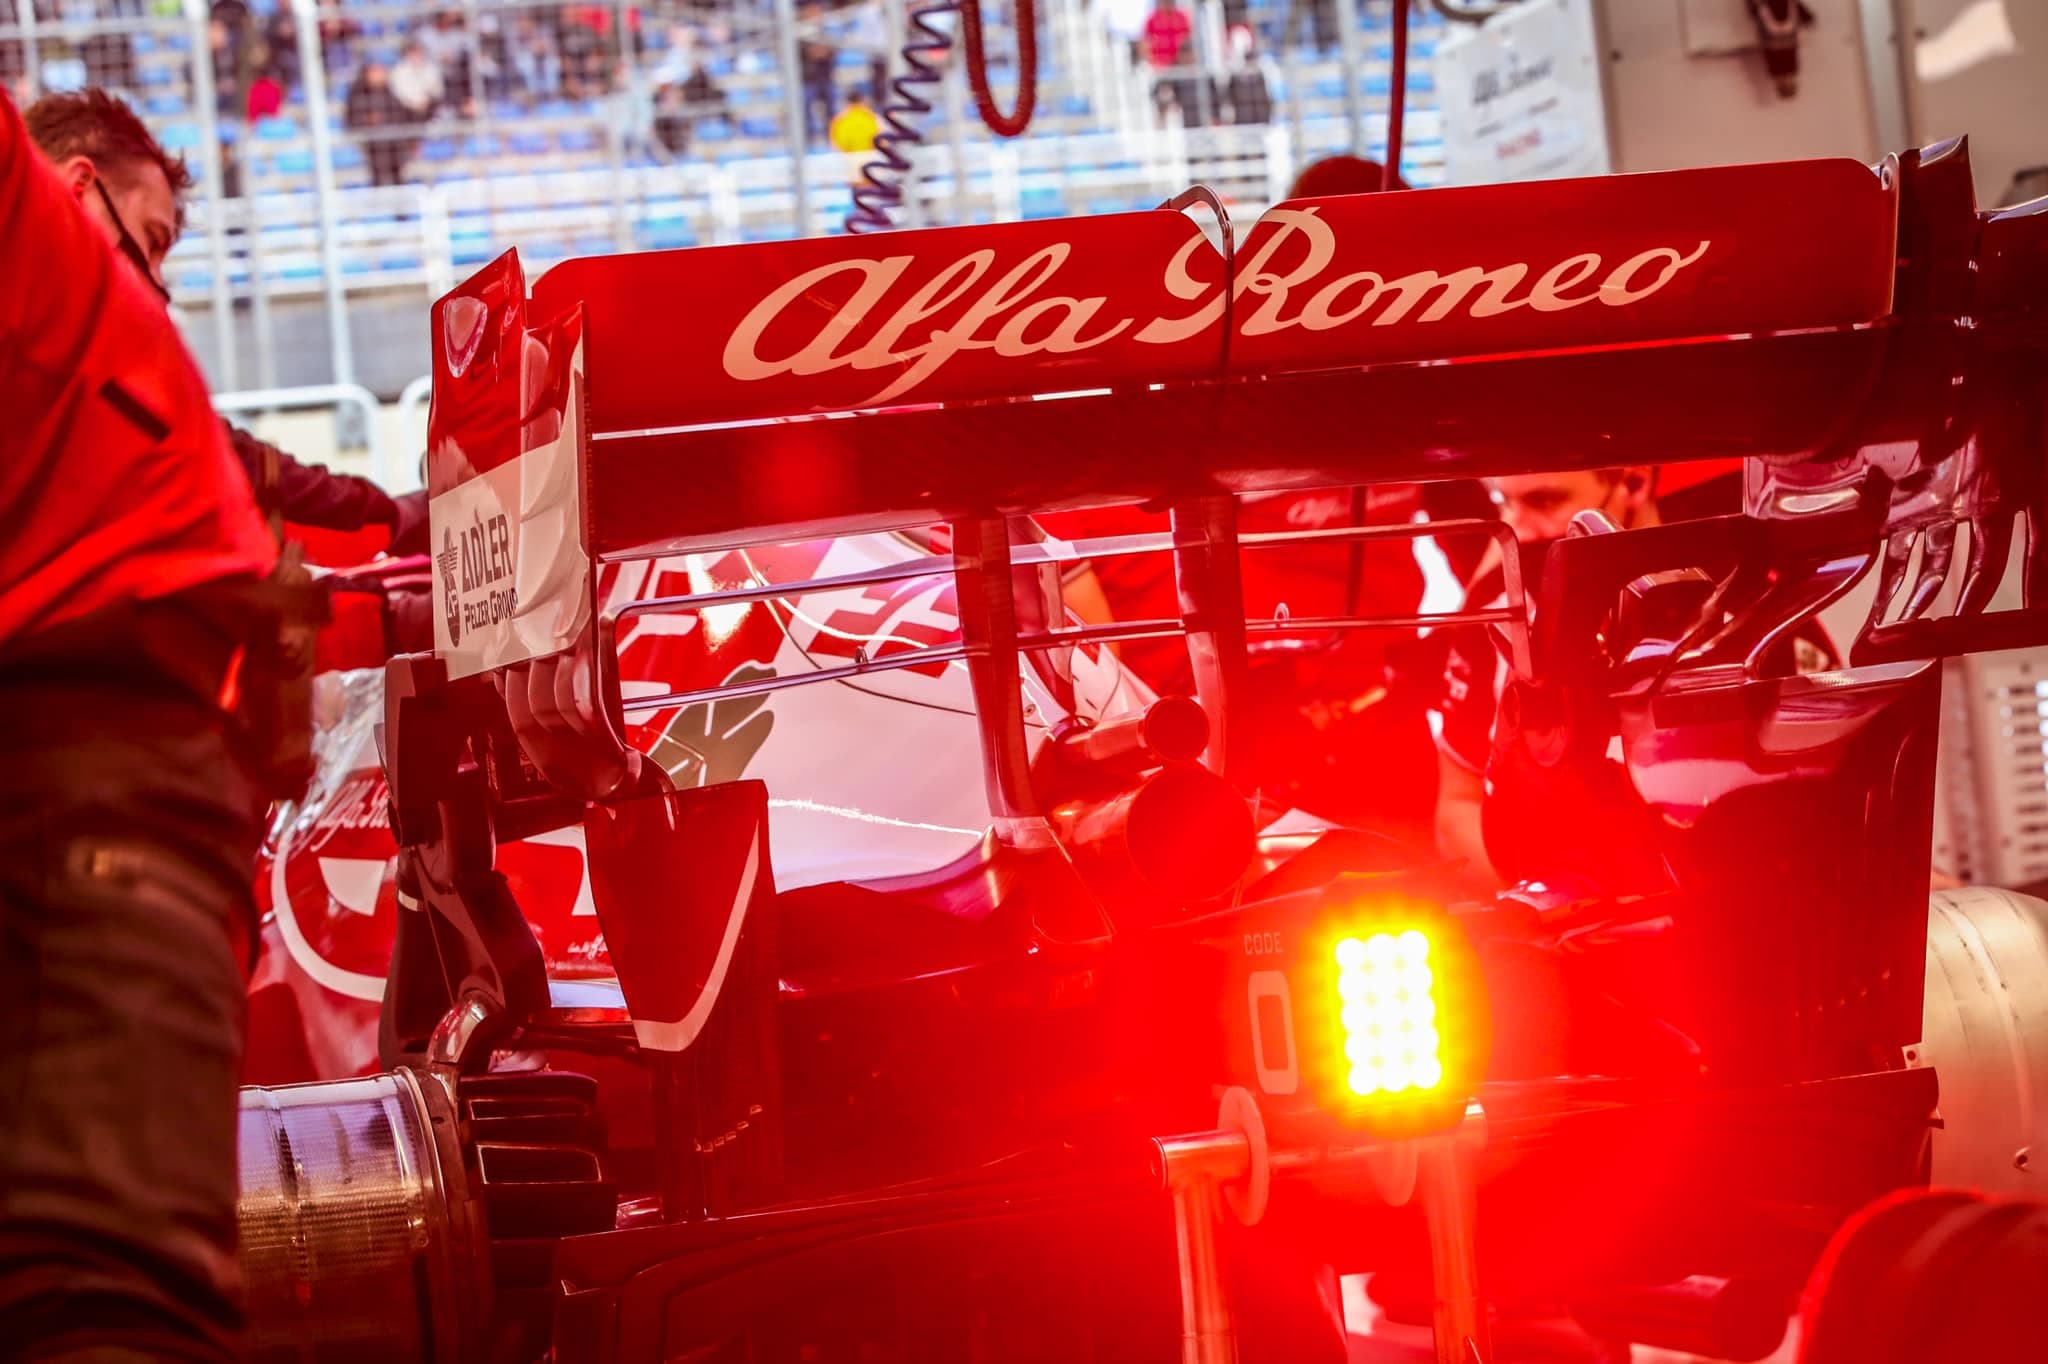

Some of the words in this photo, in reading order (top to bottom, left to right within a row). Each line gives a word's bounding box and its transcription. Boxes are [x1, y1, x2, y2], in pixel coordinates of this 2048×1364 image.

[723, 242, 1134, 412] Alfa
[1133, 206, 1711, 343] Romeo
[460, 513, 513, 594] ADLER
[463, 600, 491, 635] PELZER
[489, 588, 519, 625] GROUP
[1243, 931, 1283, 956] CODE
